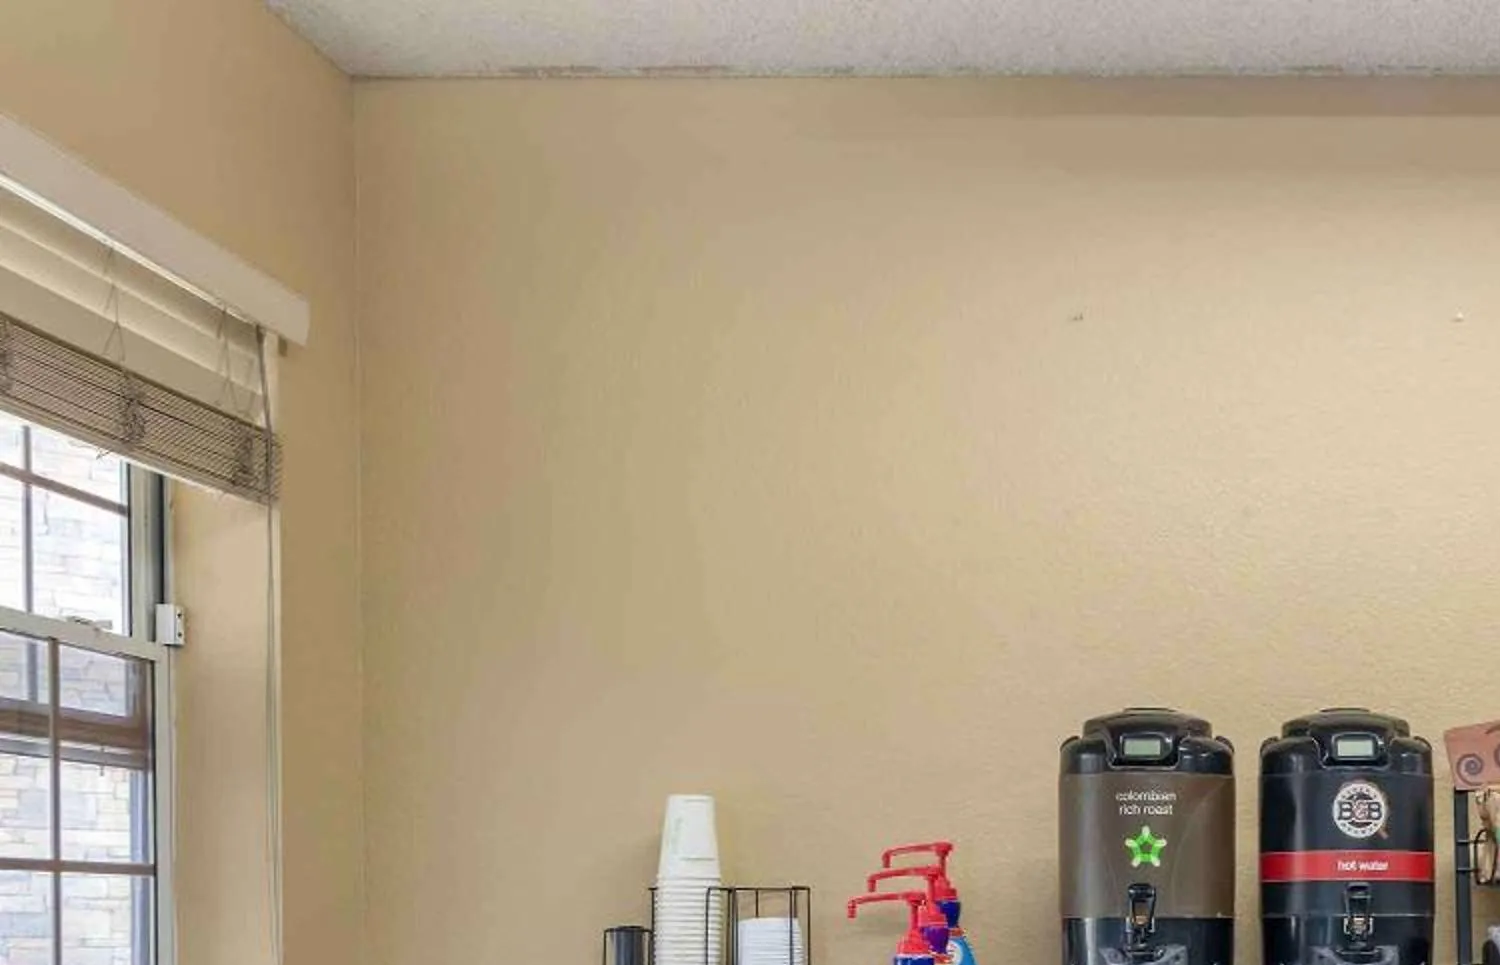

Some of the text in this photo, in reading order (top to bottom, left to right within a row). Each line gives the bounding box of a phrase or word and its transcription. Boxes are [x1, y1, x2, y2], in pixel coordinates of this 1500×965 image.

[1115, 790, 1177, 801] colombian
[1119, 804, 1173, 815] rich roast
[1337, 860, 1389, 871] hot water
